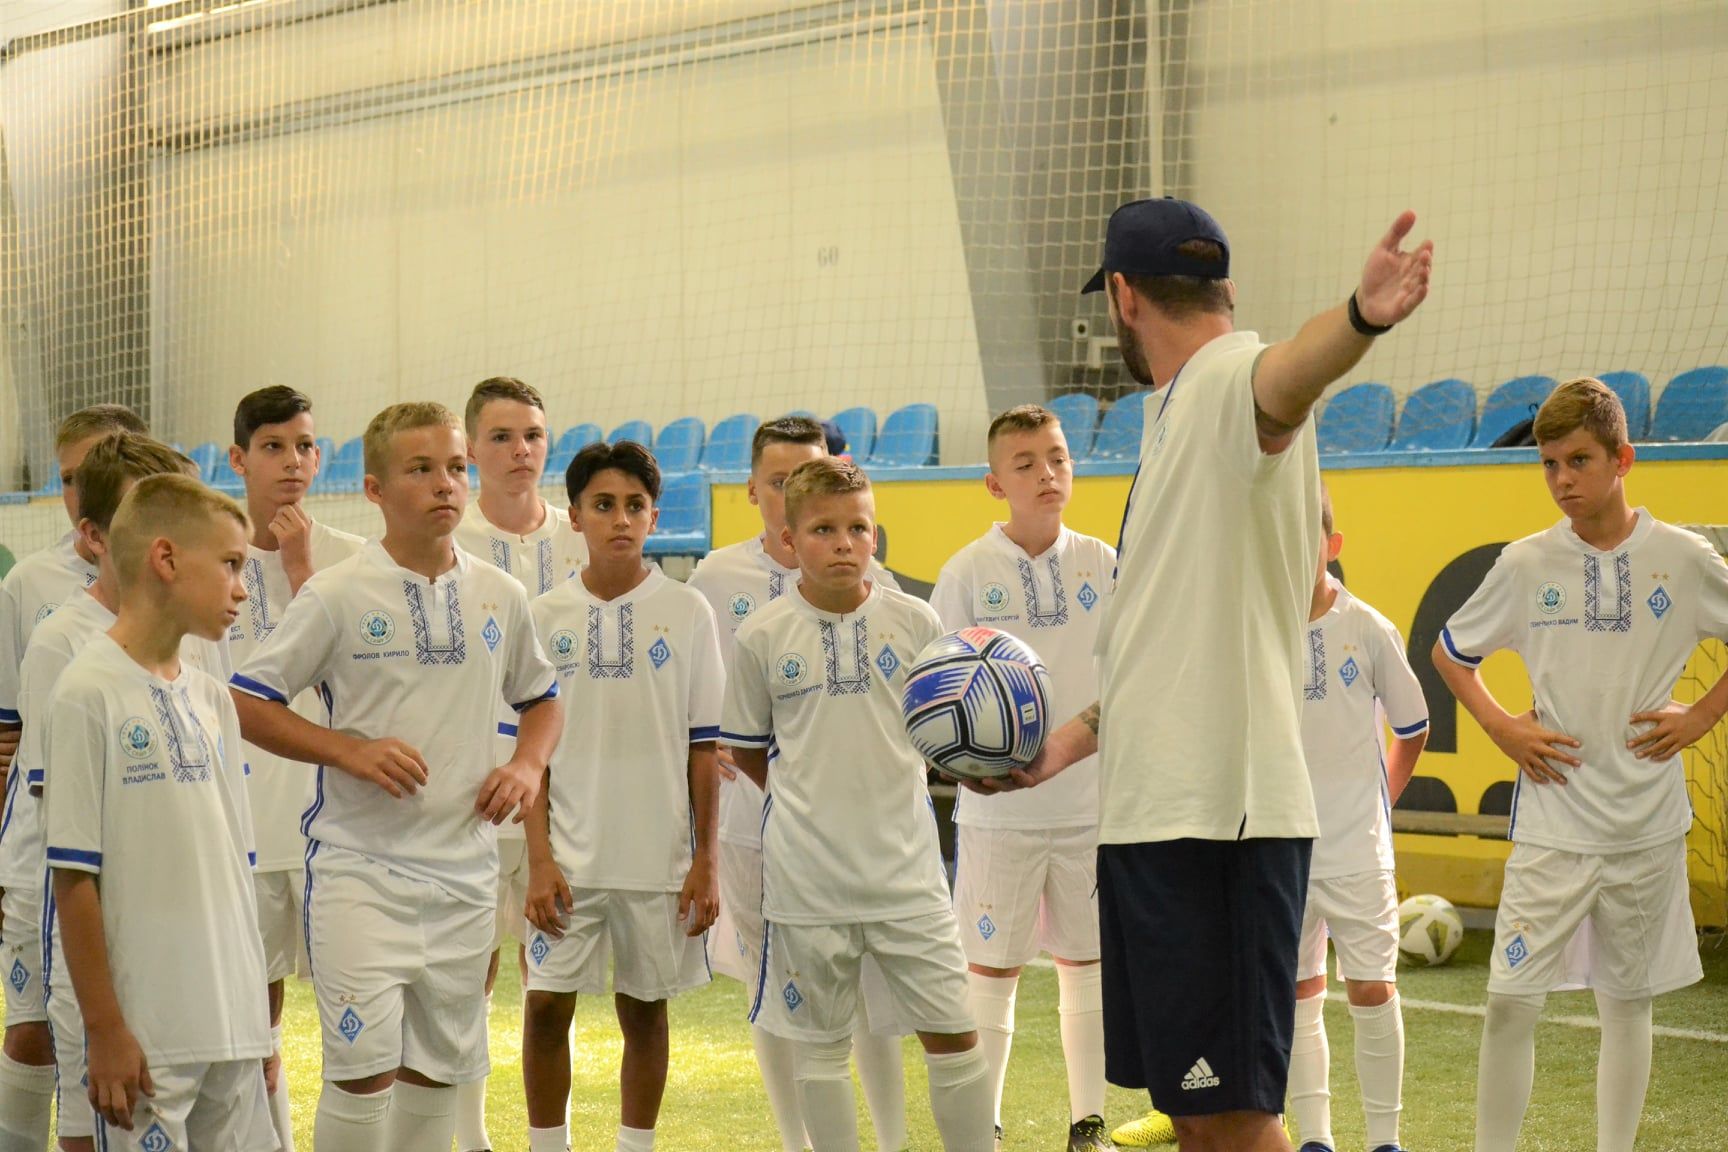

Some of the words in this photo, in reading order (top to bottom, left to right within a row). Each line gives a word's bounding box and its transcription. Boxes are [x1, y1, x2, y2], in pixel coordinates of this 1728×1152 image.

[383, 650, 410, 658] КИРИЛО
[122, 772, 166, 785] ВЛАДИСЛАВ
[1181, 1076, 1220, 1090] adidas
